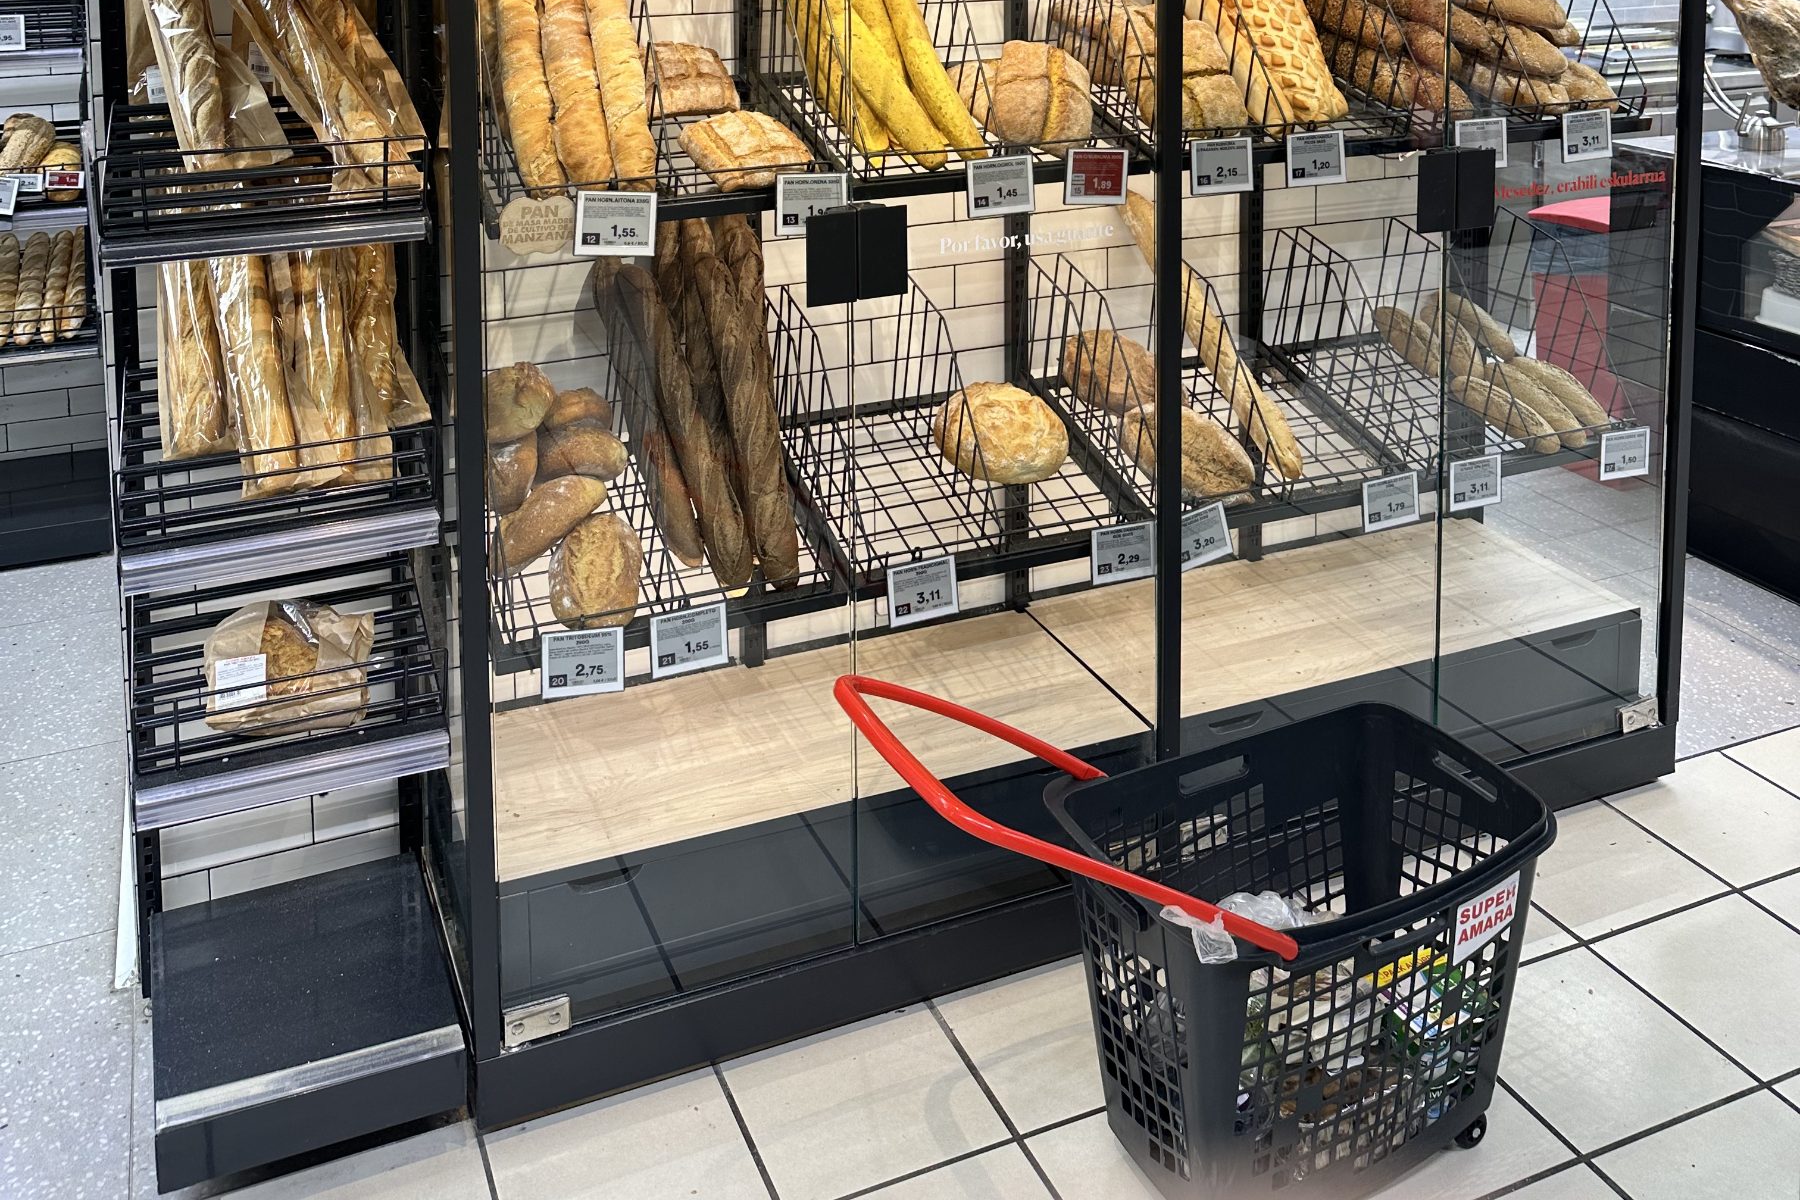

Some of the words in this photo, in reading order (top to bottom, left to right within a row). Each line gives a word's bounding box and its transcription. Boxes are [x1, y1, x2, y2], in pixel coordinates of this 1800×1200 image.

[1582, 136, 1600, 147] 3,11
[1312, 159, 1330, 172] 1,20
[1216, 166, 1238, 178] 2,15
[1093, 176, 1112, 190] 1,89
[1557, 175, 1597, 193] erabili
[1599, 170, 1666, 188] eskularrua
[997, 186, 1018, 200] 1,45
[977, 198, 986, 206] 14
[521, 205, 559, 219] PAN
[503, 220, 514, 228] DE
[516, 219, 541, 227] MASA
[543, 217, 574, 225] MADRE
[786, 216, 796, 224] 13
[521, 225, 556, 233] CULTIVO
[611, 224, 636, 239] 1,55
[502, 231, 574, 244] MANZANA
[586, 235, 596, 244] 12
[939, 237, 970, 255] Por
[975, 234, 1022, 251] favor,
[1622, 454, 1637, 465] 1,50
[1470, 482, 1488, 494] 3,11
[1387, 502, 1405, 513] 1,79
[1193, 536, 1215, 550] 3,20
[1118, 553, 1140, 566] 2,29
[1100, 566, 1110, 574] 23
[916, 589, 940, 605] 3,11
[898, 606, 909, 615] 22
[685, 640, 709, 654] 1,55
[662, 656, 672, 665] 21
[575, 663, 604, 678] 2,75
[552, 677, 565, 686] 20
[1457, 903, 1514, 945] AMARA
